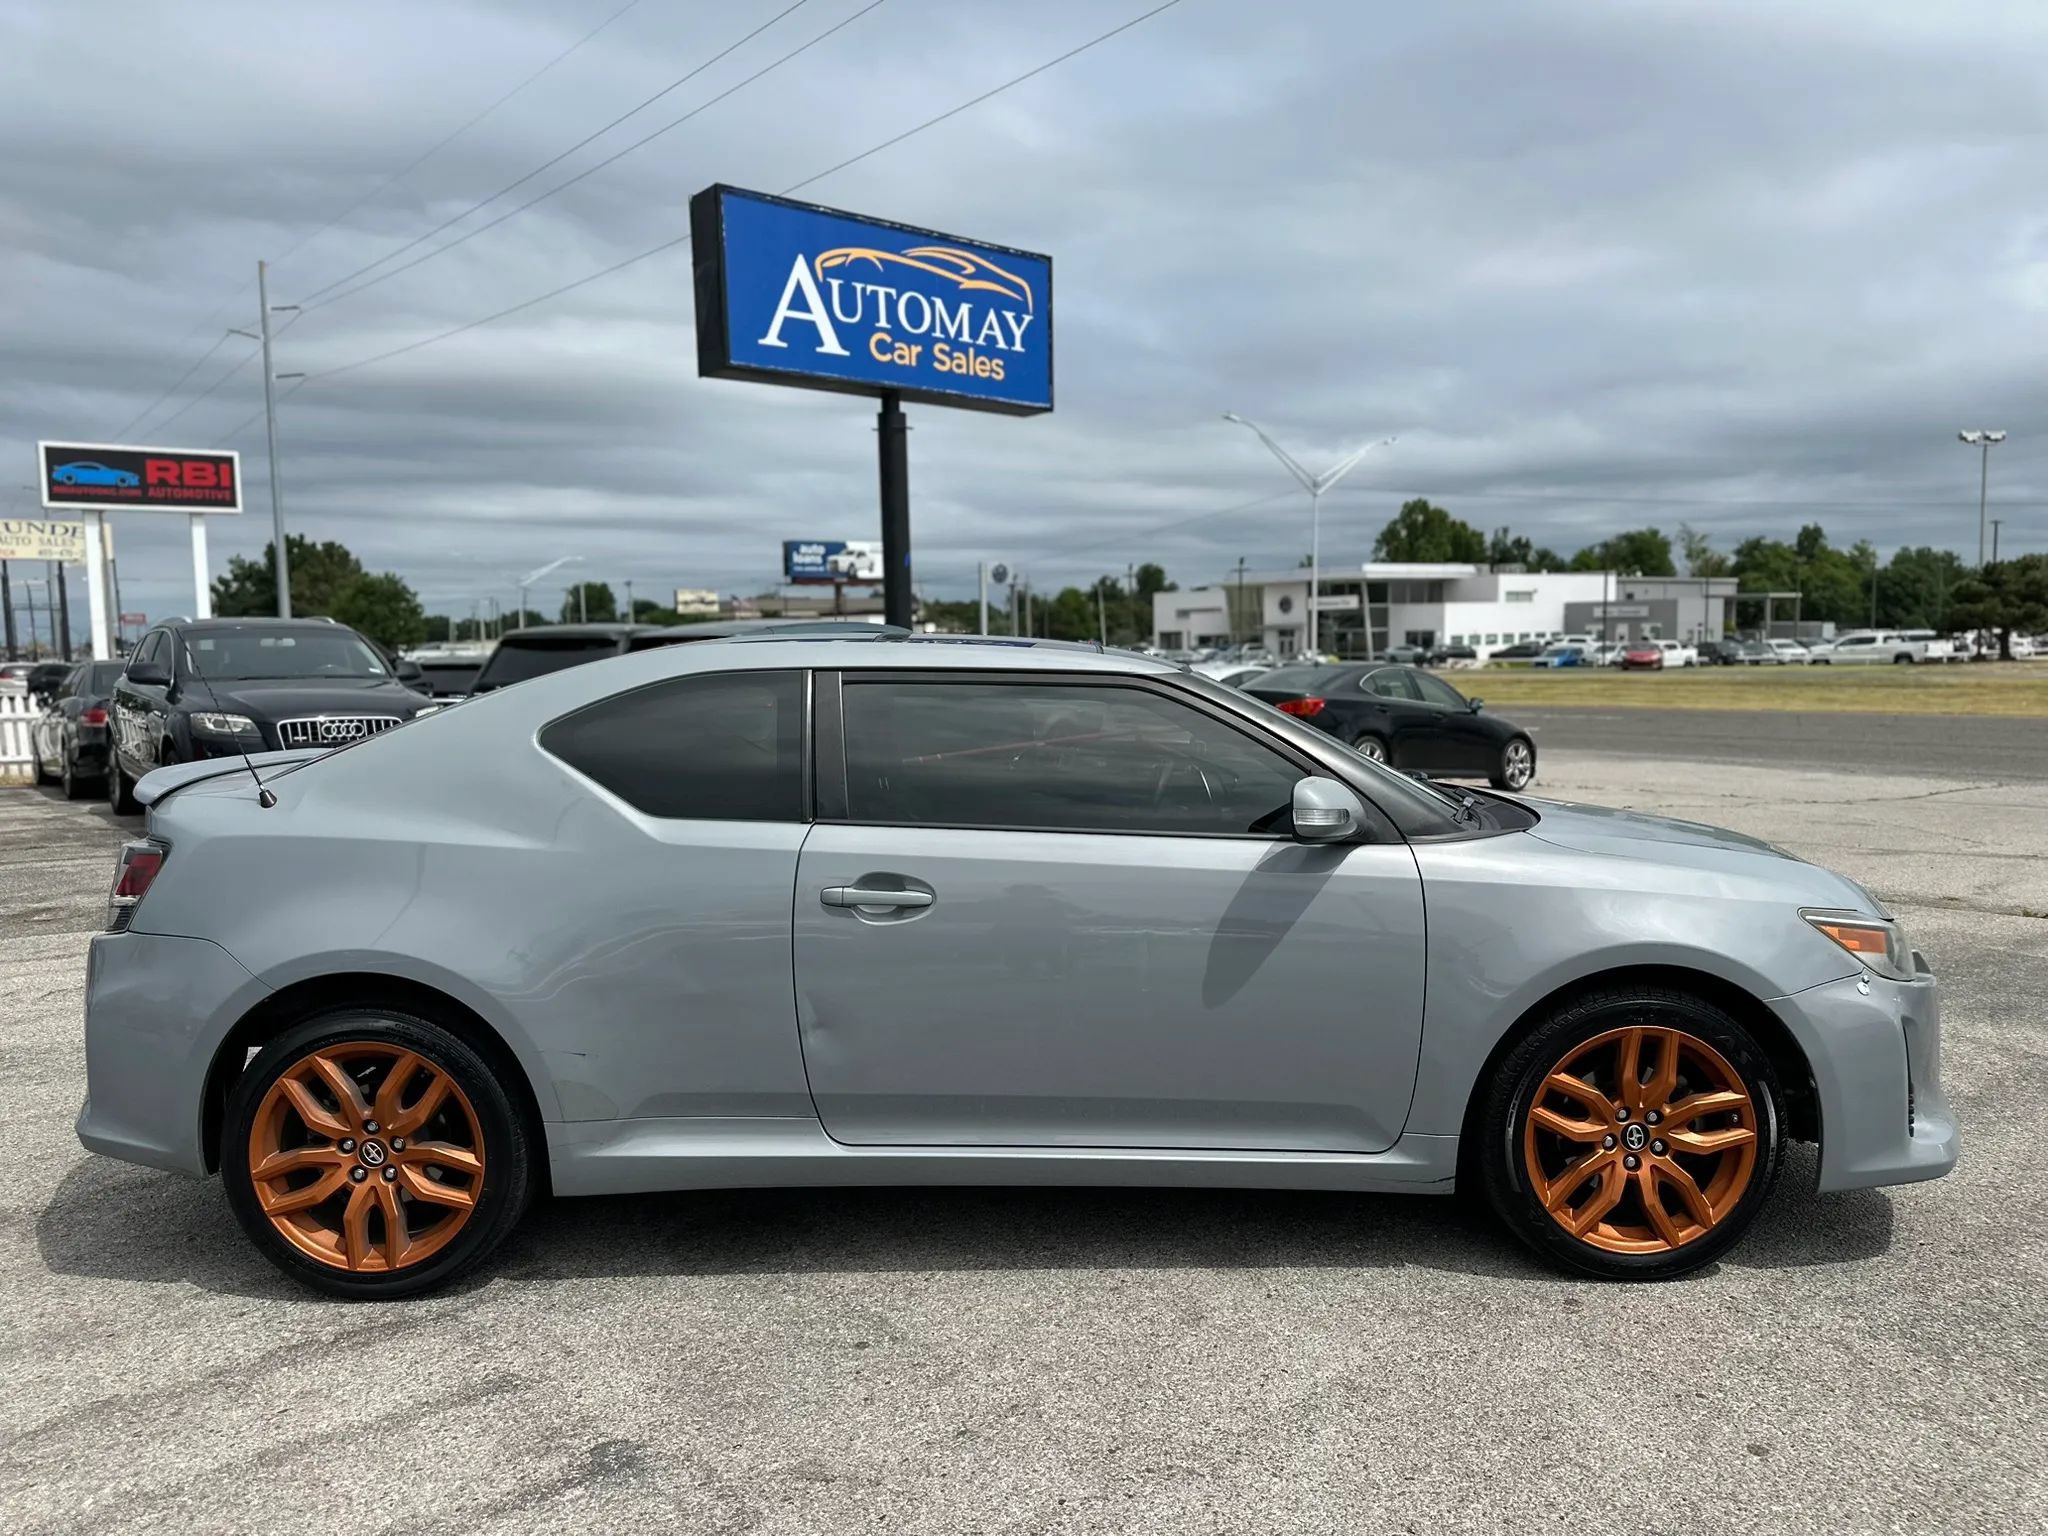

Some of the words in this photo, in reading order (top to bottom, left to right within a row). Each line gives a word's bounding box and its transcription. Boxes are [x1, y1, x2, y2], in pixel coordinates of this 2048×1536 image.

[758, 254, 1034, 356] AUTOMAY
[869, 332, 922, 366] Car
[933, 343, 1005, 380] Sales
[145, 459, 232, 488] RBI
[148, 487, 231, 501] AUTOMOTIVE
[0, 533, 32, 547] AUTO
[38, 536, 76, 548] SALES
